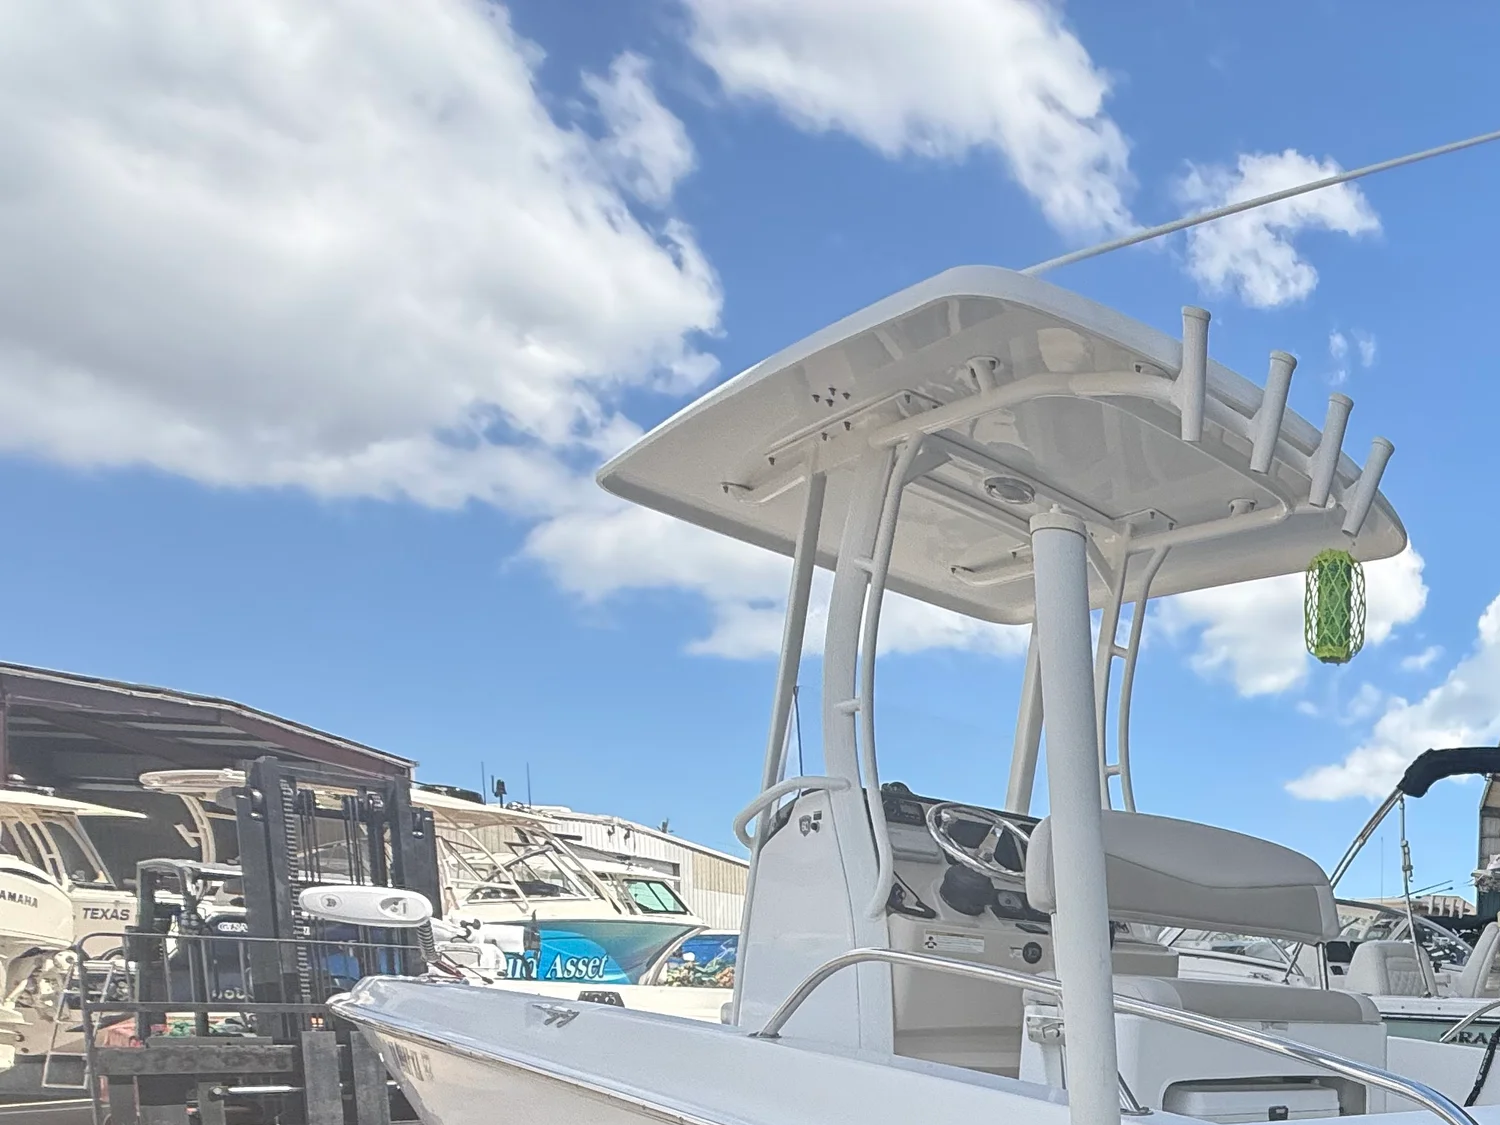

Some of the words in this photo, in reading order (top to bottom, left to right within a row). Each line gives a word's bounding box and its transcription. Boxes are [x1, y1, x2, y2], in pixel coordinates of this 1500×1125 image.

[0, 889, 38, 909] AMAHA
[82, 907, 131, 921] TEXAS
[545, 953, 608, 980] Asset
